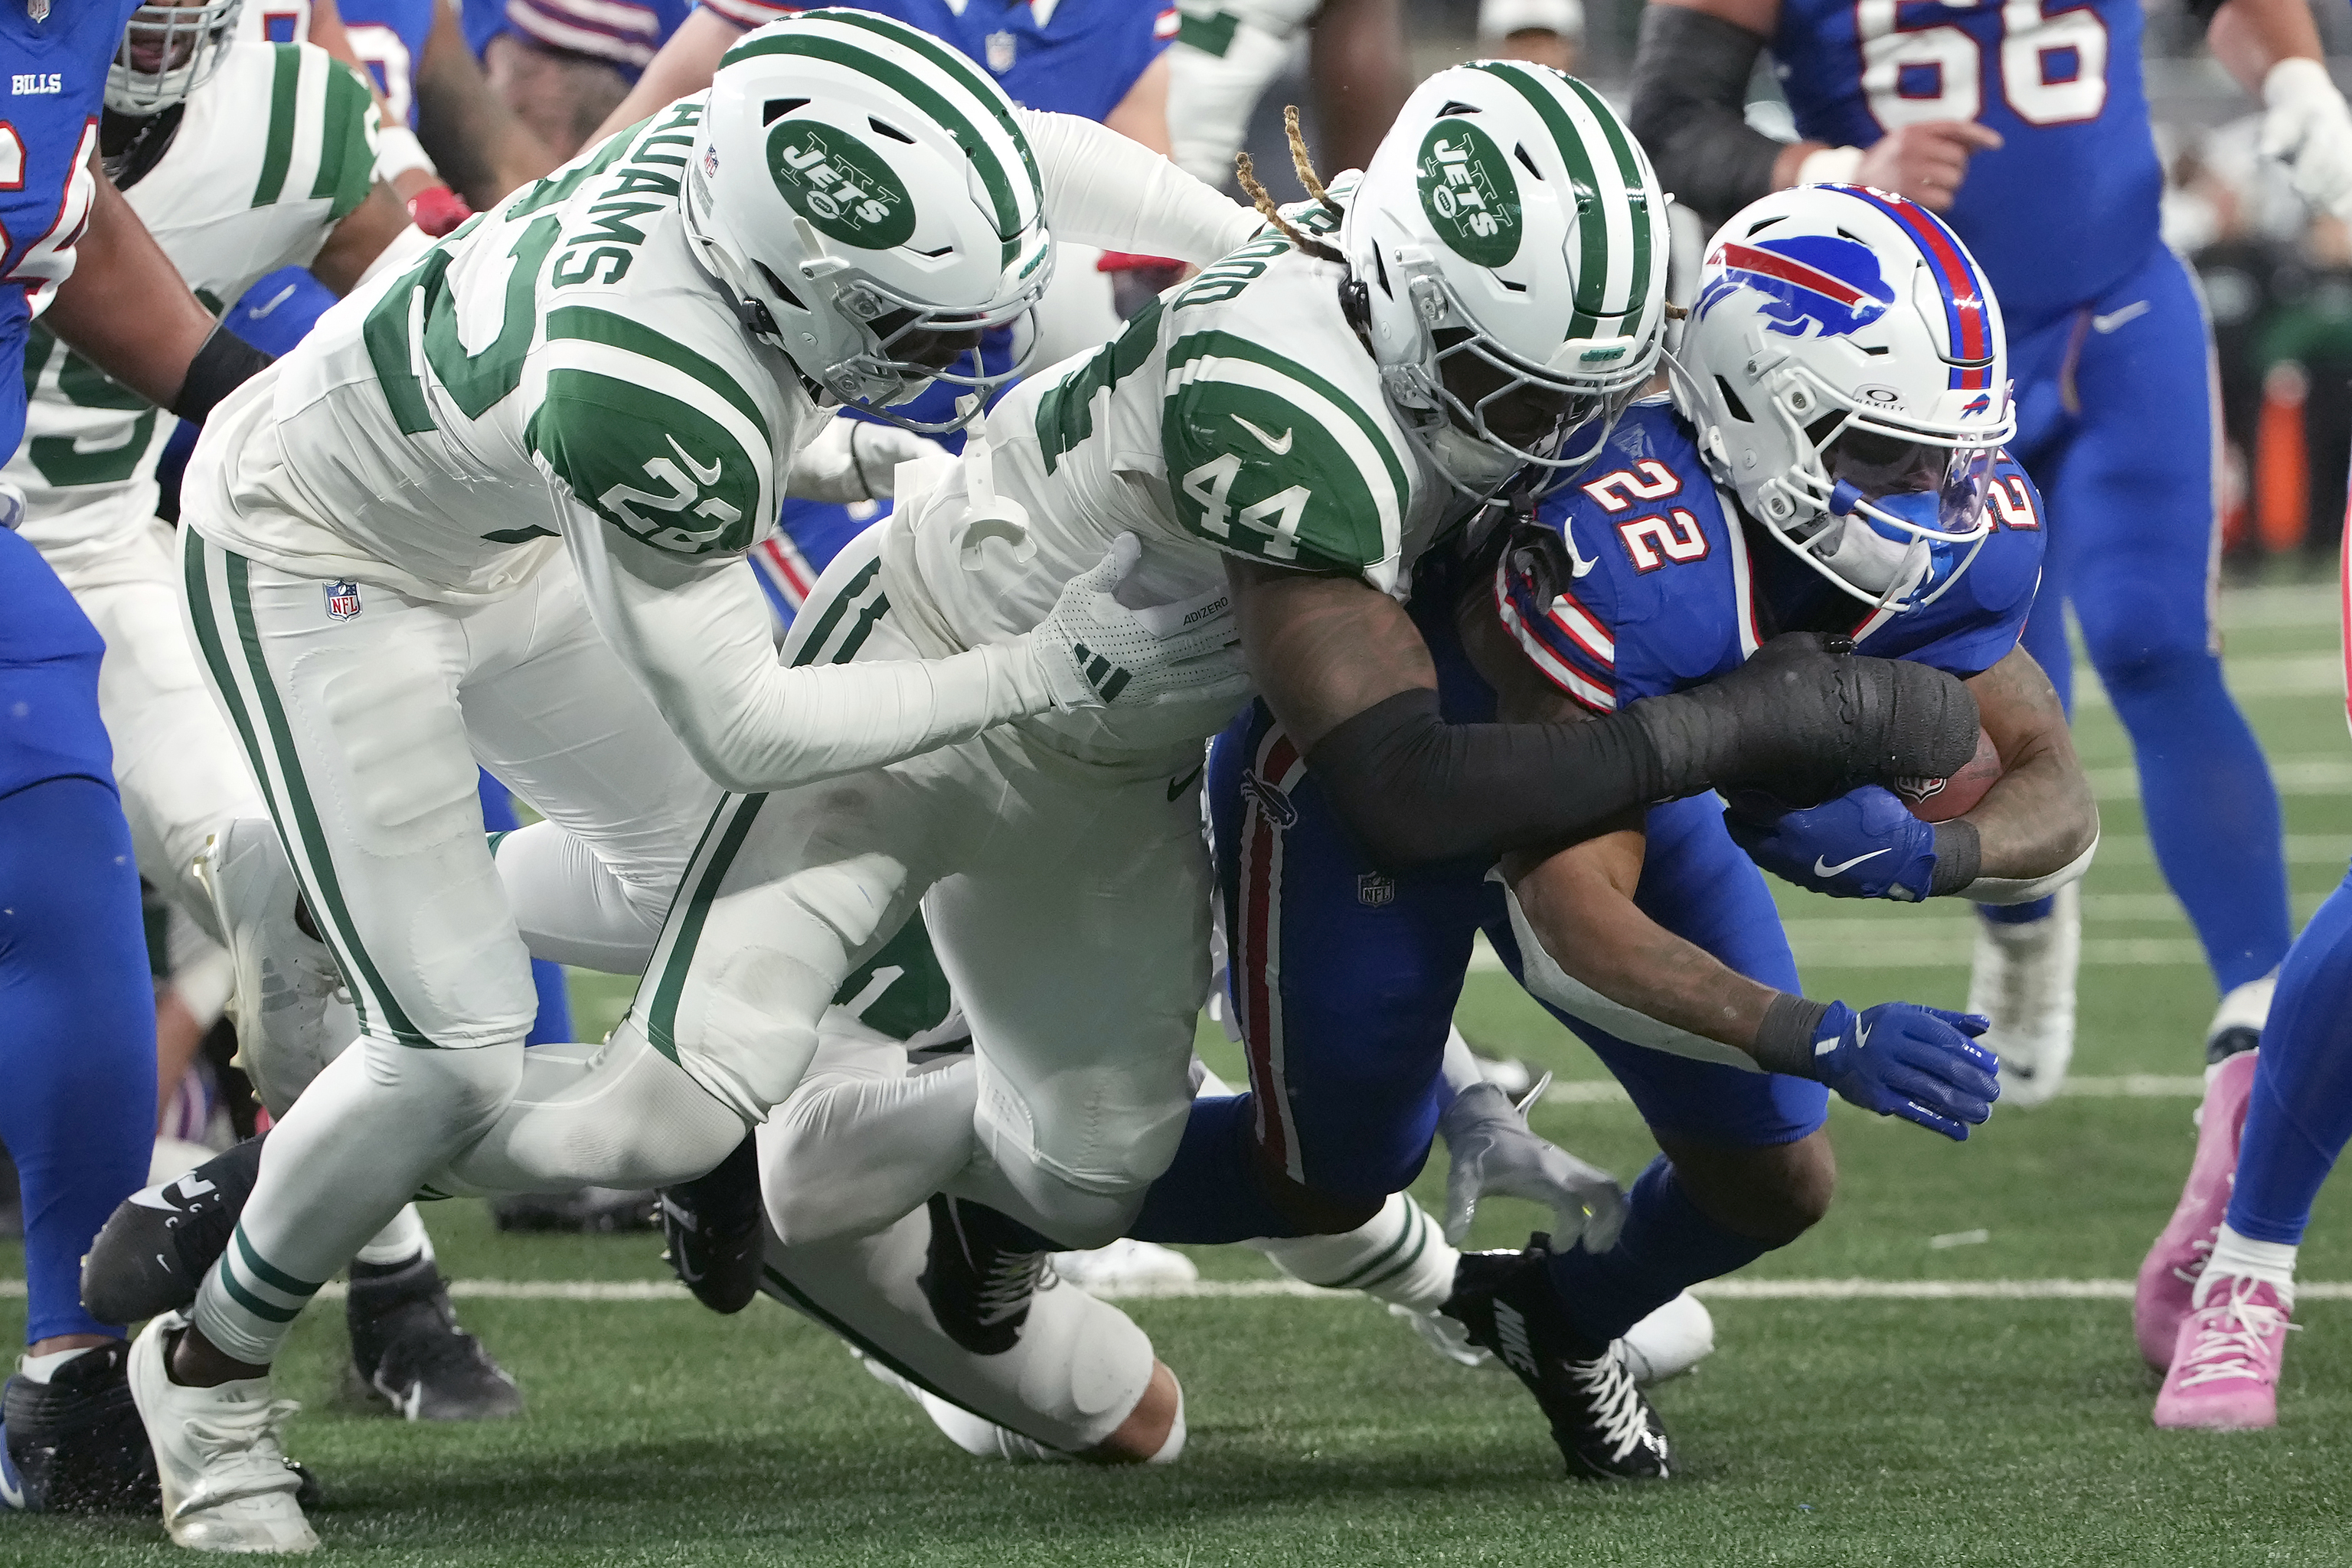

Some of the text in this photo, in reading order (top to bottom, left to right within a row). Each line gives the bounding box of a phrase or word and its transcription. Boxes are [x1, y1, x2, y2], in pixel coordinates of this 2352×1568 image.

[11, 73, 62, 95] BILLS
[782, 145, 890, 223] JETS
[1434, 139, 1498, 237] JETS
[597, 457, 742, 553] 22
[1182, 452, 1312, 560] 44
[1578, 457, 1712, 575] 22
[332, 596, 358, 616] NFL
[1183, 596, 1228, 626] ADIZERO
[1364, 887, 1390, 903] NFL
